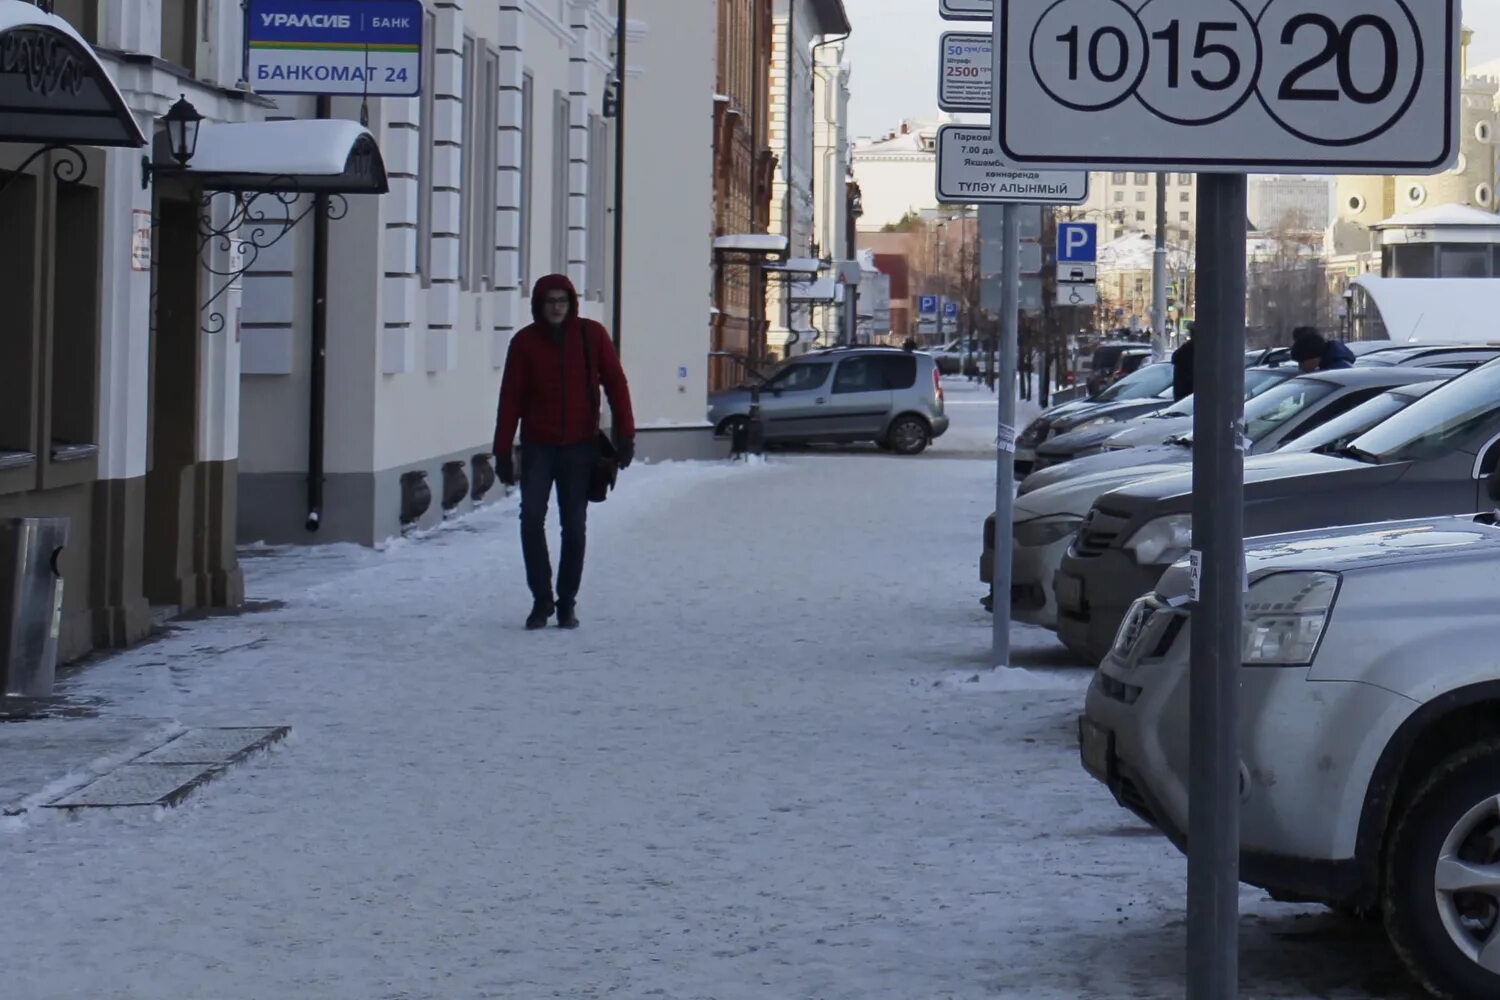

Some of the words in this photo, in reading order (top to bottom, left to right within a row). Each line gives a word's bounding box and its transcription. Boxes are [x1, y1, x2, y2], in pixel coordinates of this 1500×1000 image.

[260, 13, 350, 28] УРАЛСИБ
[372, 17, 410, 28] БАНК
[948, 46, 963, 56] 50
[1055, 25, 1130, 83] 10
[1152, 19, 1241, 91] 15
[1277, 13, 1399, 104] 20
[257, 64, 377, 81] БАНКОМАТ
[384, 67, 408, 83] 24
[946, 66, 979, 77] 2500
[961, 146, 980, 154] 7.00
[999, 183, 1068, 194] АЛЫНМЫЙ
[1066, 227, 1088, 258] P
